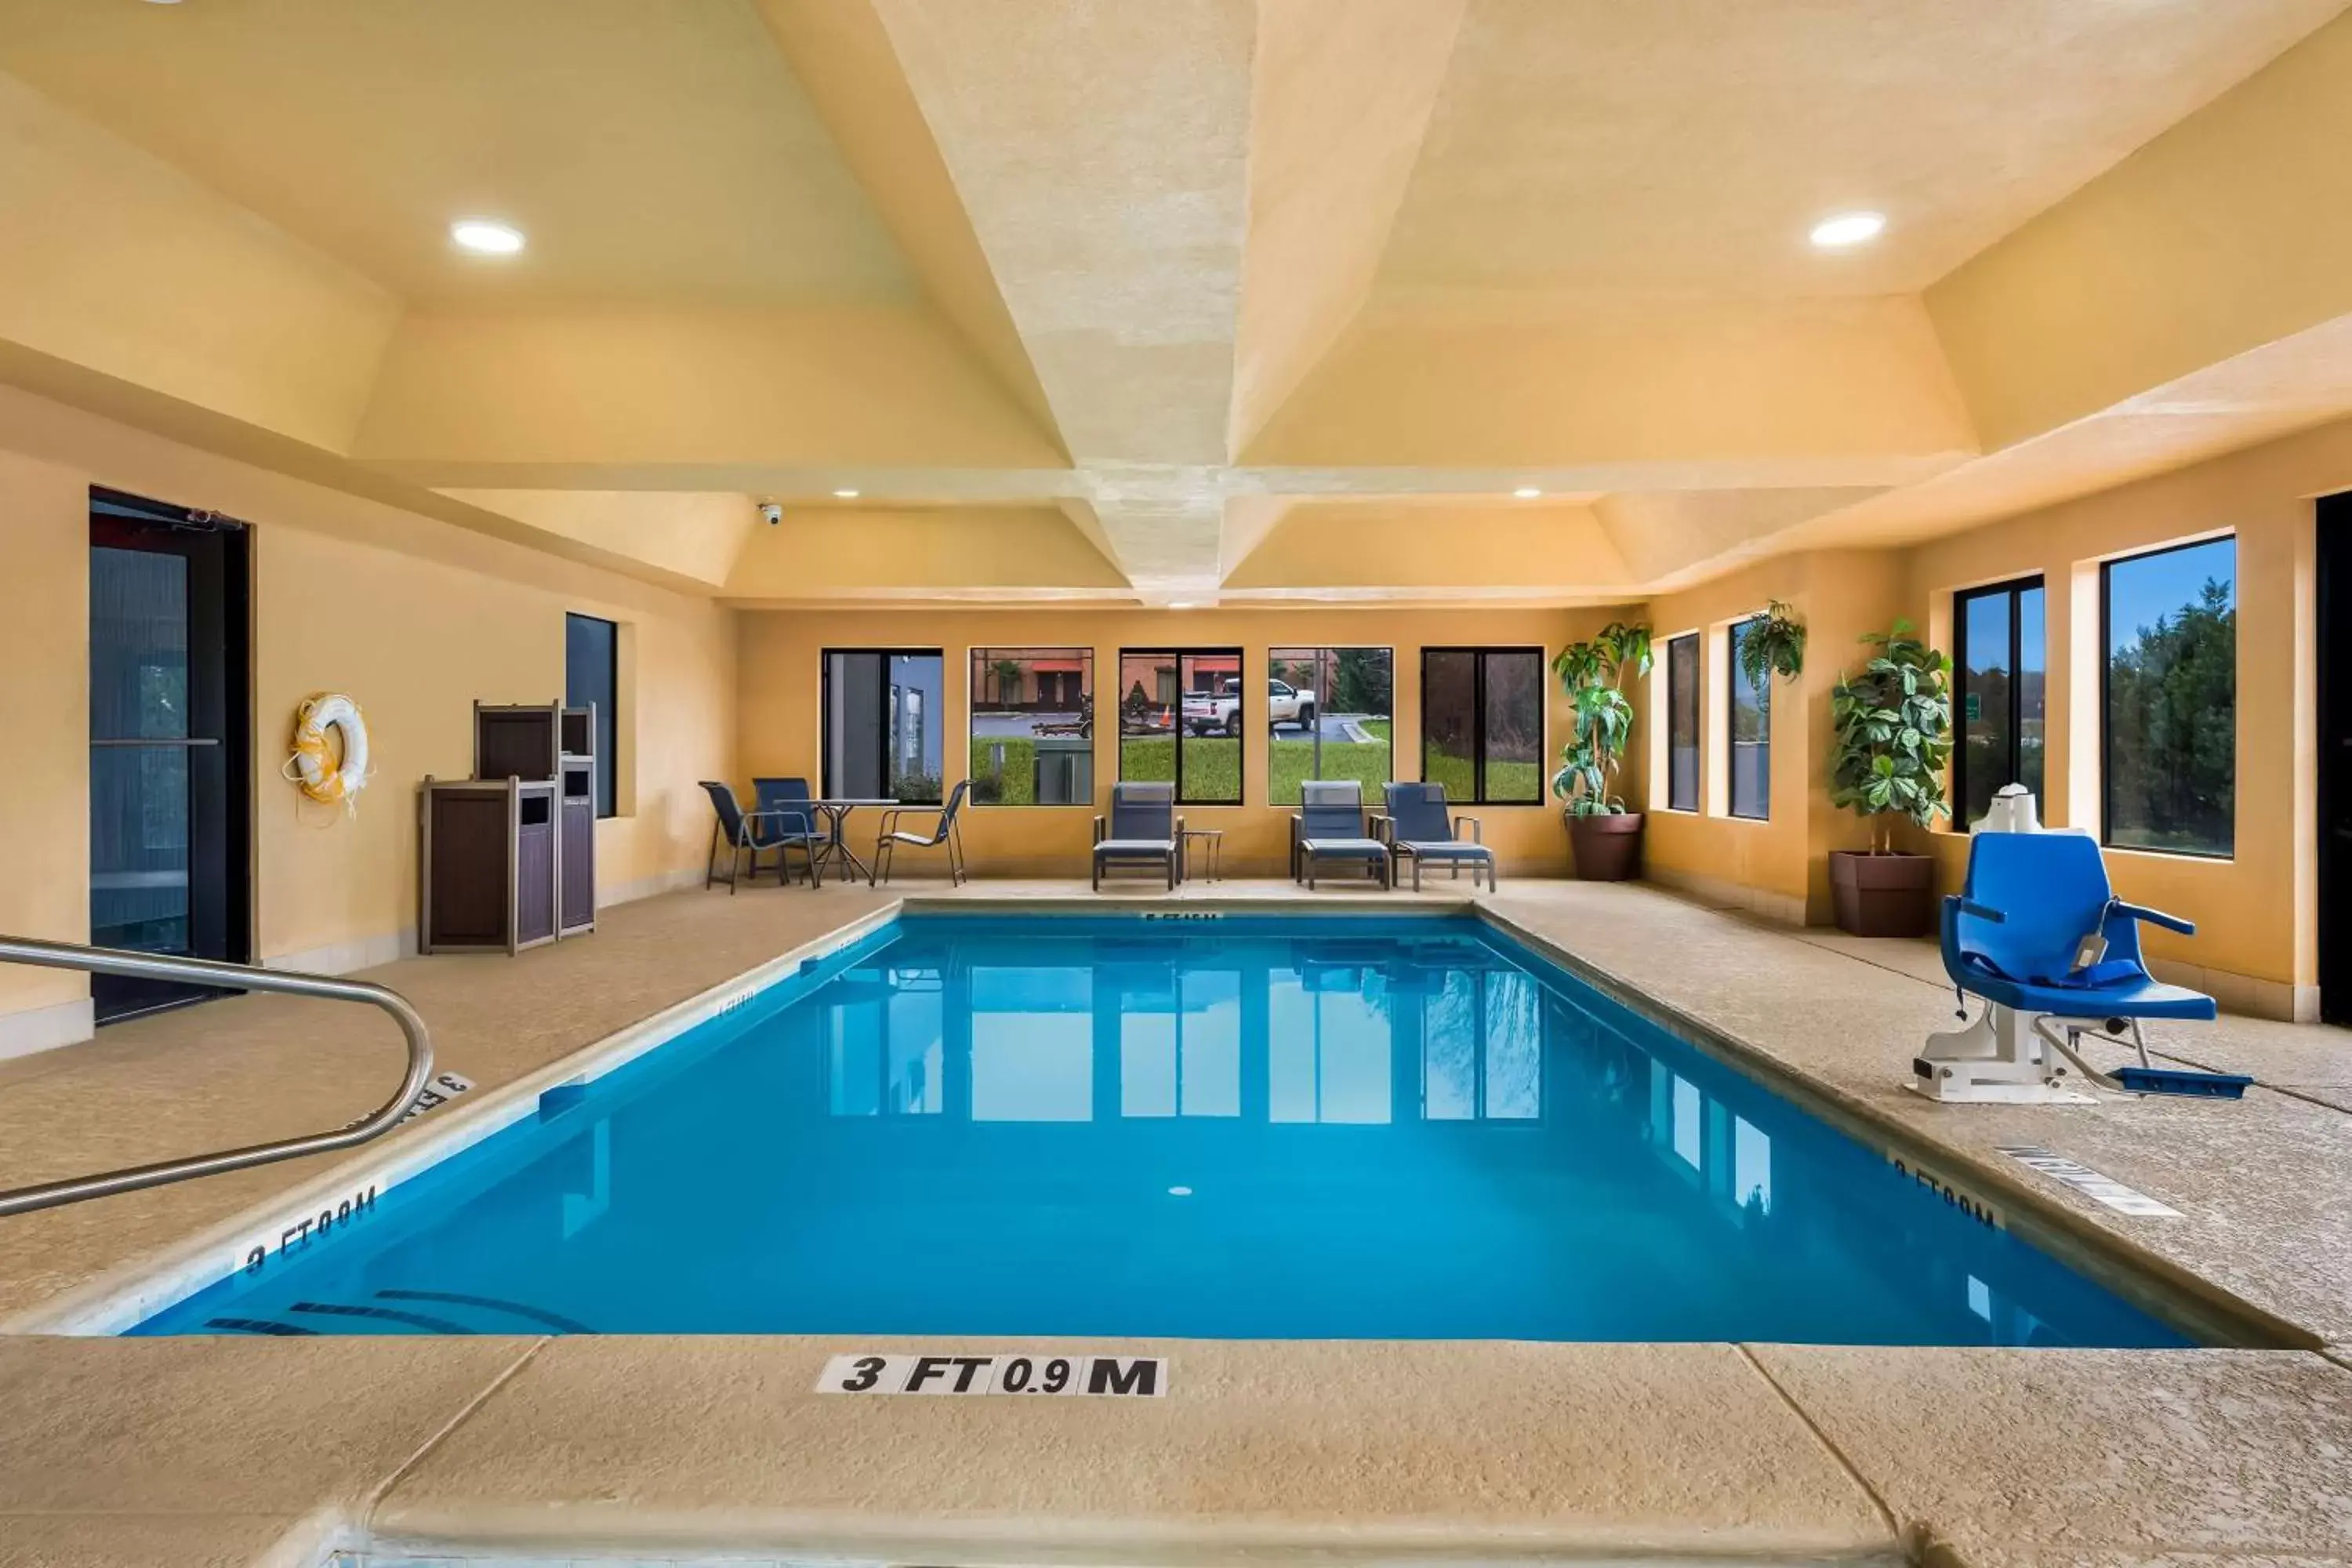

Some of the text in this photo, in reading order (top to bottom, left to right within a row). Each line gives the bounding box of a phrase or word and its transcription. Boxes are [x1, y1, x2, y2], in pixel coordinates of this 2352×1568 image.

[842, 1357, 1158, 1395] 3 FT 0.9 M
